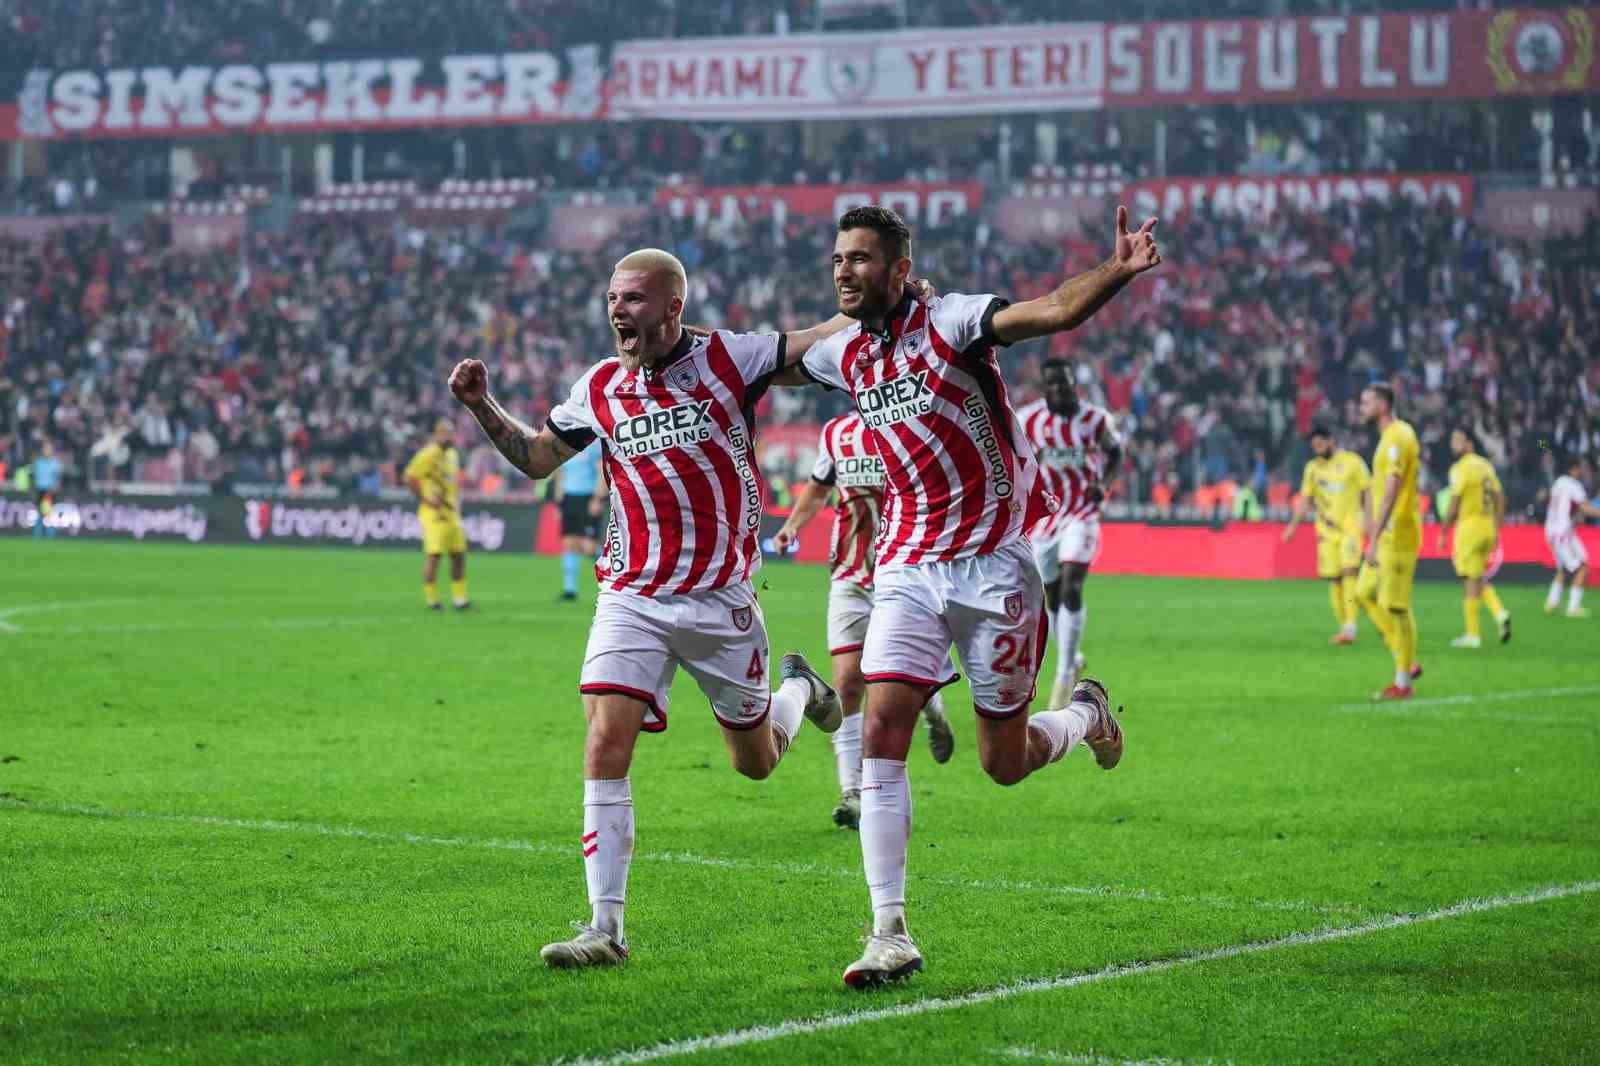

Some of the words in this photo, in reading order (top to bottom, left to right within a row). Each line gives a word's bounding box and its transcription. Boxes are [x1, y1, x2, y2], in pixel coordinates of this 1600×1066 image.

[612, 56, 808, 98] ARMAMIZ
[856, 373, 932, 414] COREX
[615, 400, 713, 445] COREX
[867, 400, 930, 427] HOLDING
[624, 430, 709, 457] HOLDING
[837, 458, 886, 475] CORE
[746, 648, 764, 684] 4
[991, 634, 1031, 674] 24
